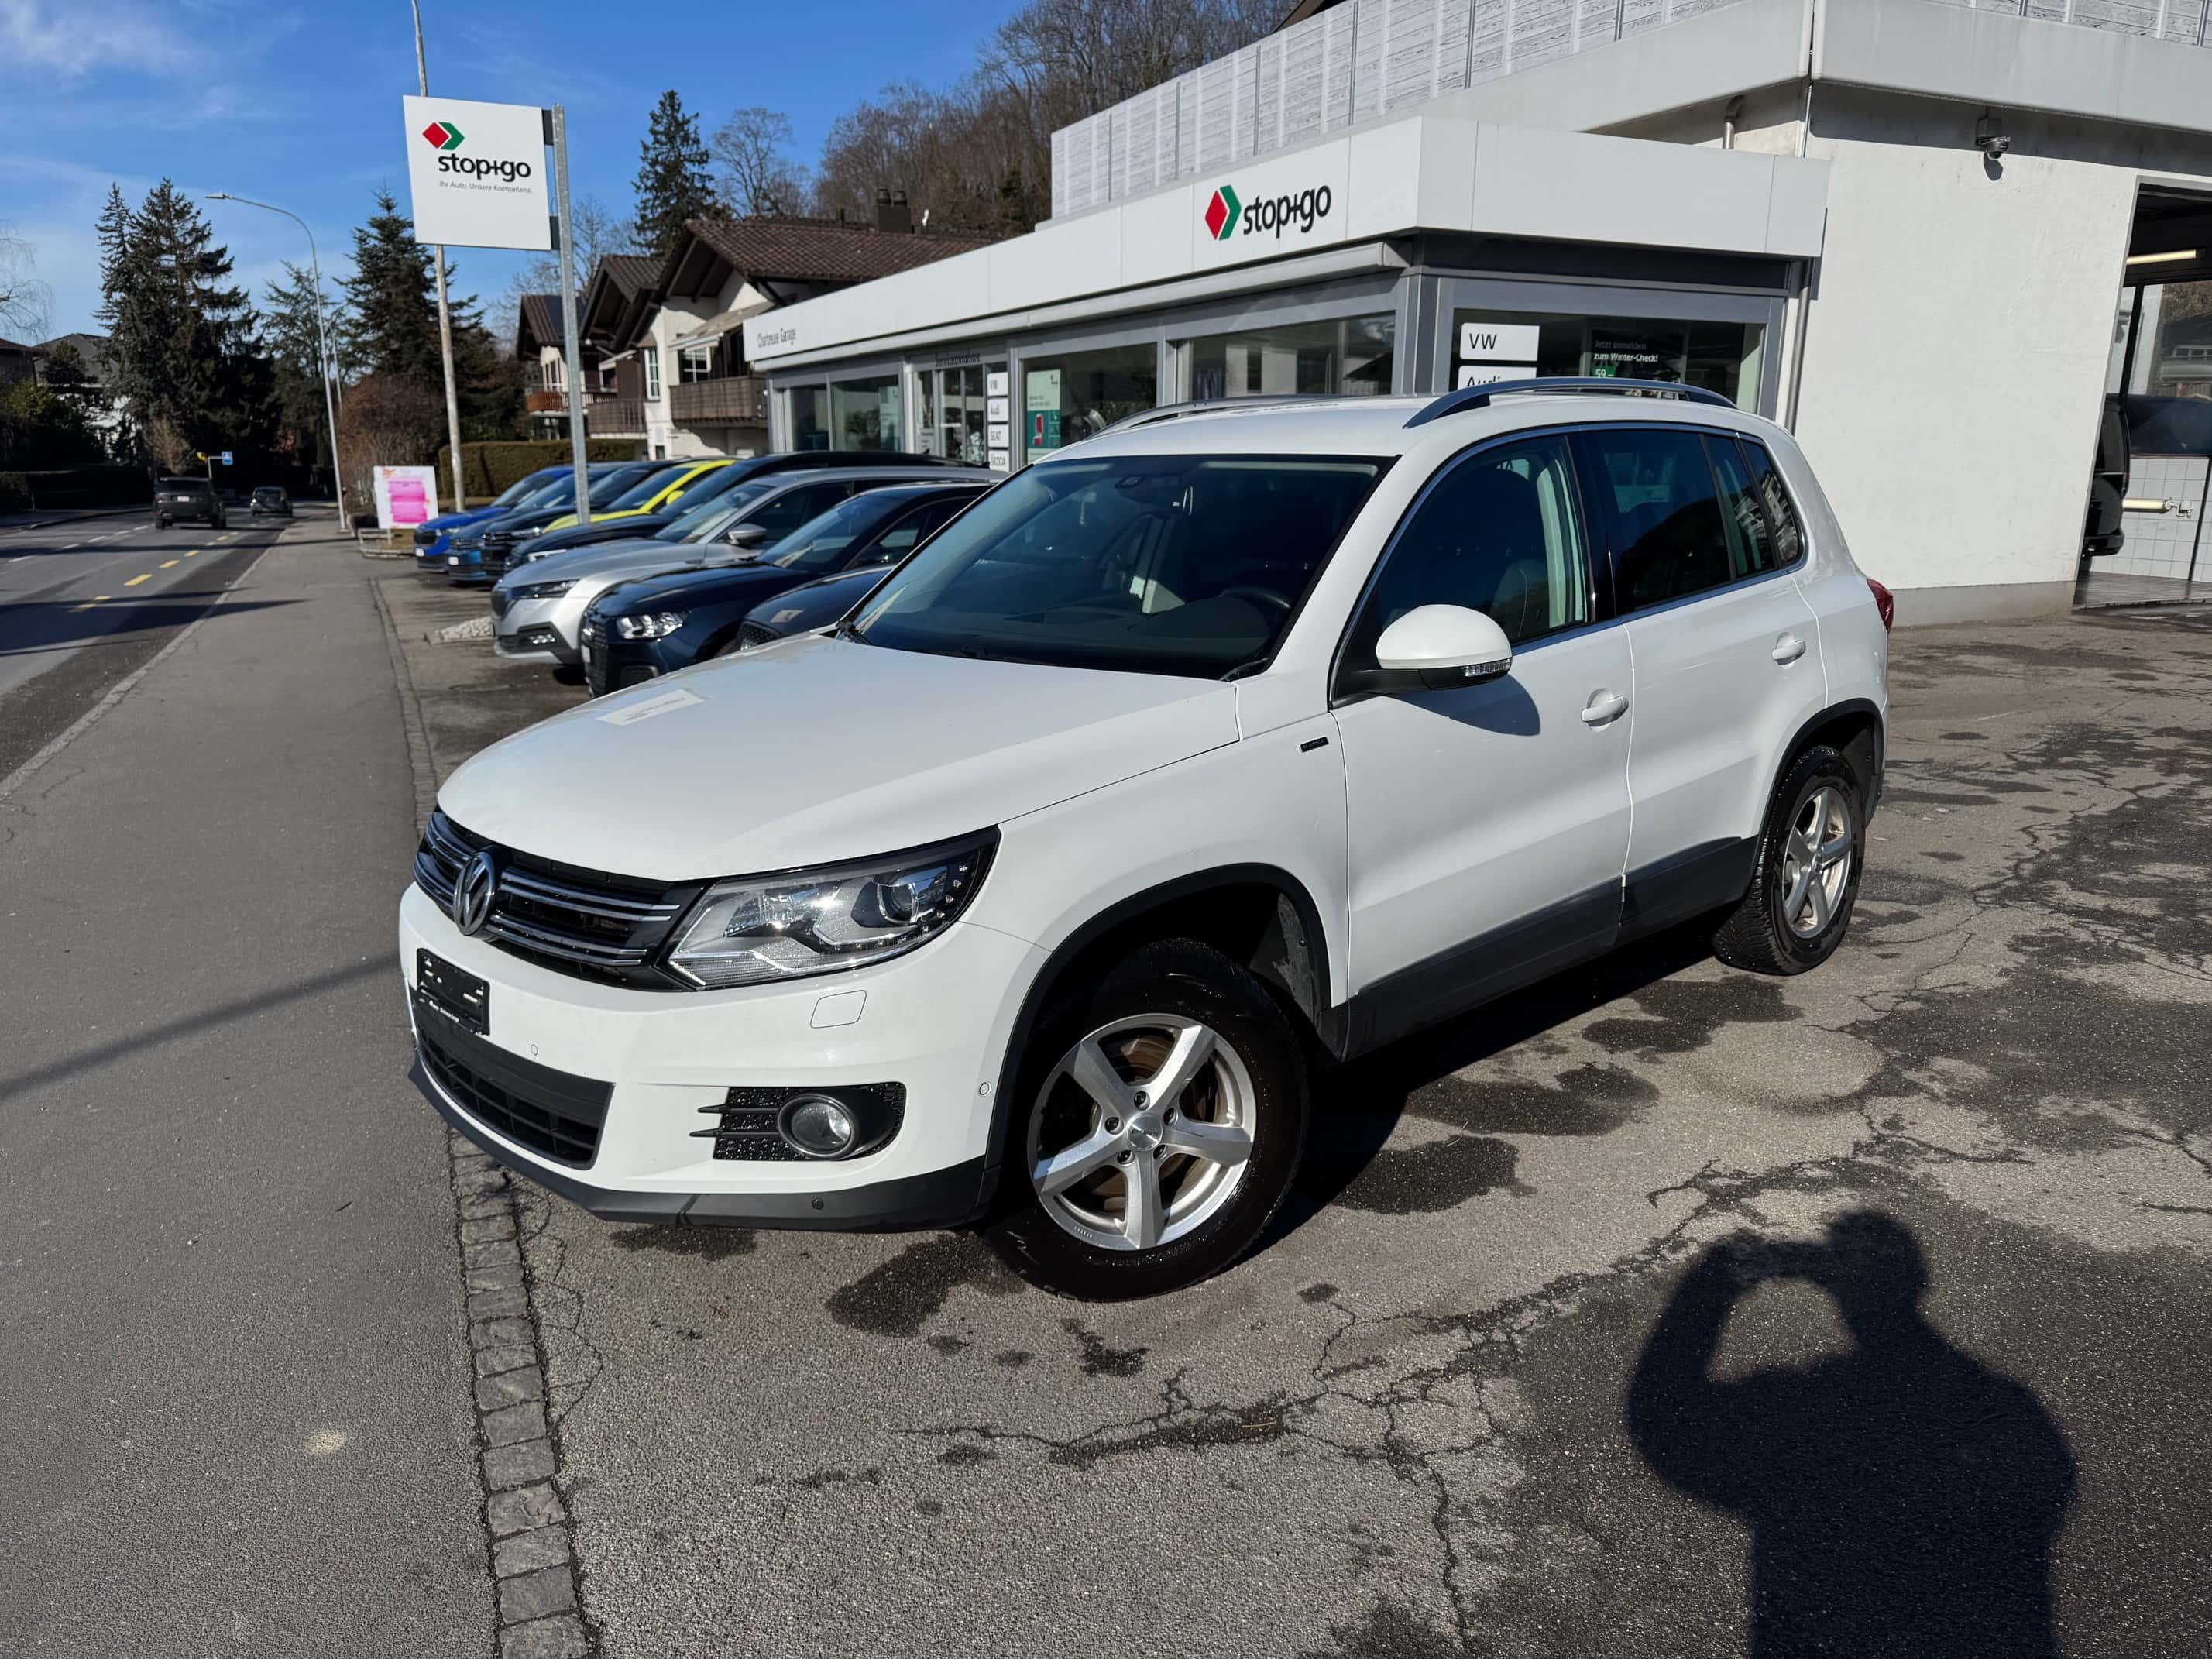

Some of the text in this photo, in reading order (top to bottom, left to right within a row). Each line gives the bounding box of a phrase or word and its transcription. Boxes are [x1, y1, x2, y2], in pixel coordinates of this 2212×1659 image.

[438, 153, 531, 182] stop+go
[1243, 185, 1331, 239] stop+go
[1468, 333, 1497, 349] VW
[1611, 353, 1658, 362] Winter-Check!
